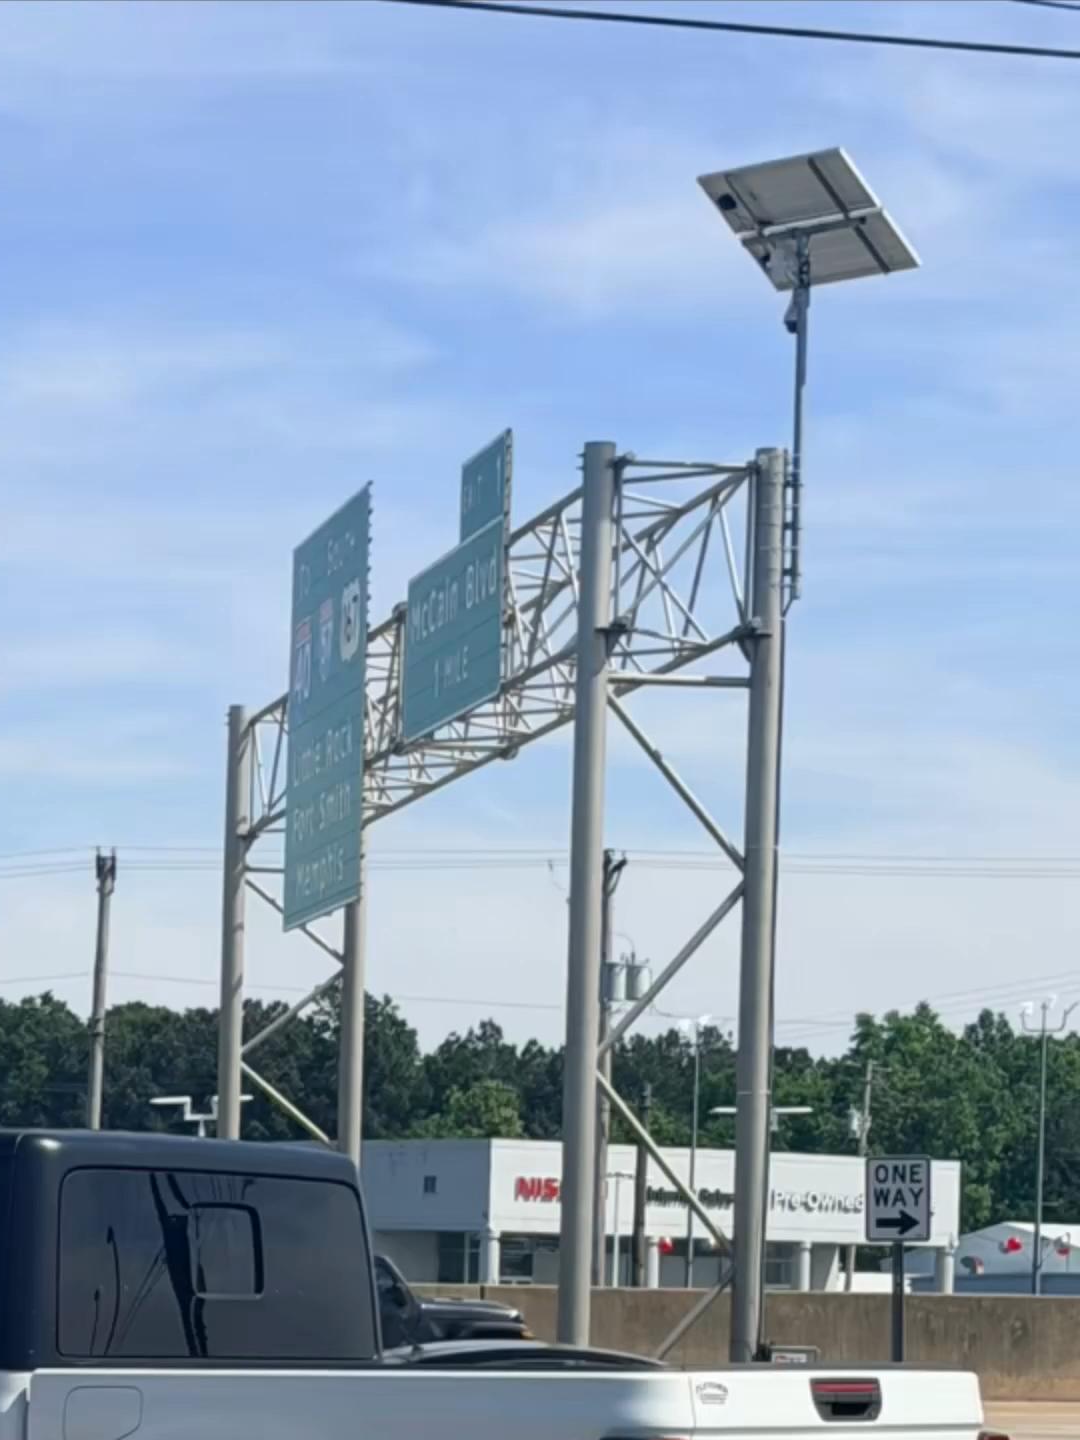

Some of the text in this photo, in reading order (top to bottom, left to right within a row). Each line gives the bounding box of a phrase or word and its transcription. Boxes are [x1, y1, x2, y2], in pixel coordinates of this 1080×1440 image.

[410, 544, 498, 643] McCain Blvd
[874, 1163, 923, 1184] ONE
[873, 1187, 924, 1208] WAY
